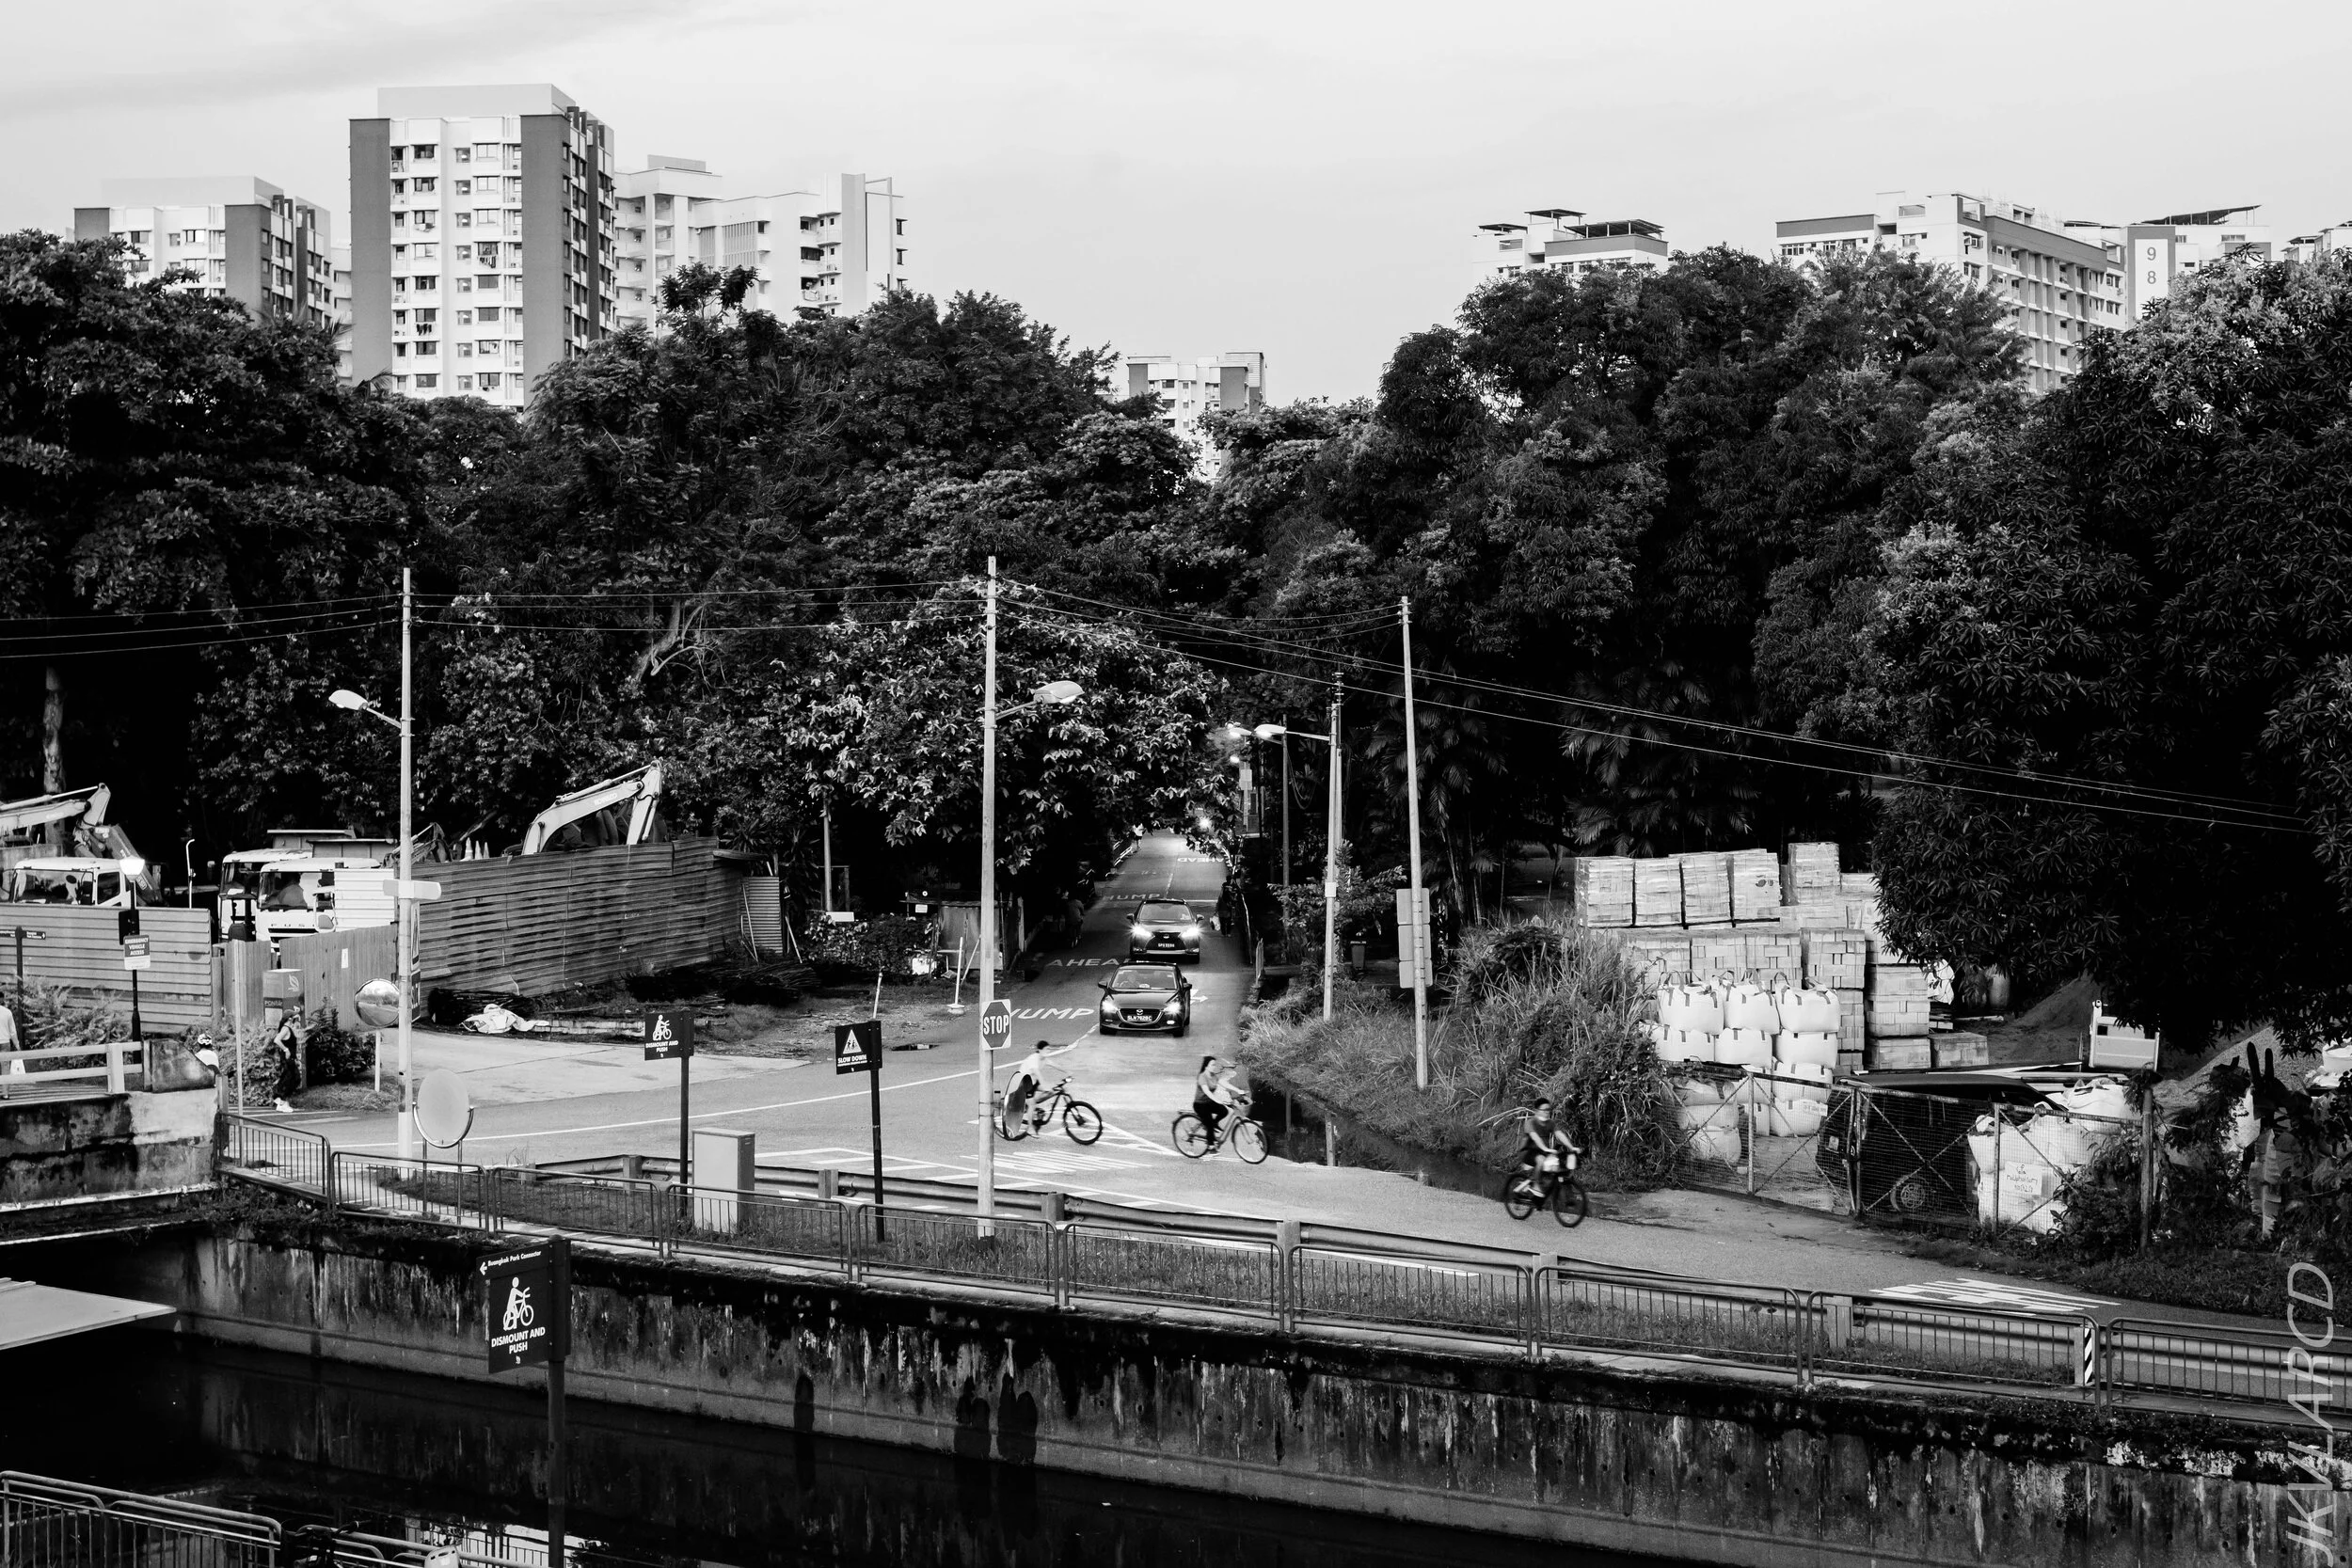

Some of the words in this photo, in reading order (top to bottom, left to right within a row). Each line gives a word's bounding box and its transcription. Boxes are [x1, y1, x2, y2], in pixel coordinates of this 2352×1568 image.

[2147, 246, 2156, 285] 98
[1102, 893, 1160, 901] HUMP
[983, 1016, 1009, 1035] STOP
[520, 1251, 541, 1259] Connector
[491, 1330, 529, 1348] DISMOUNT
[530, 1326, 546, 1339] AND
[509, 1340, 528, 1354] PUSH
